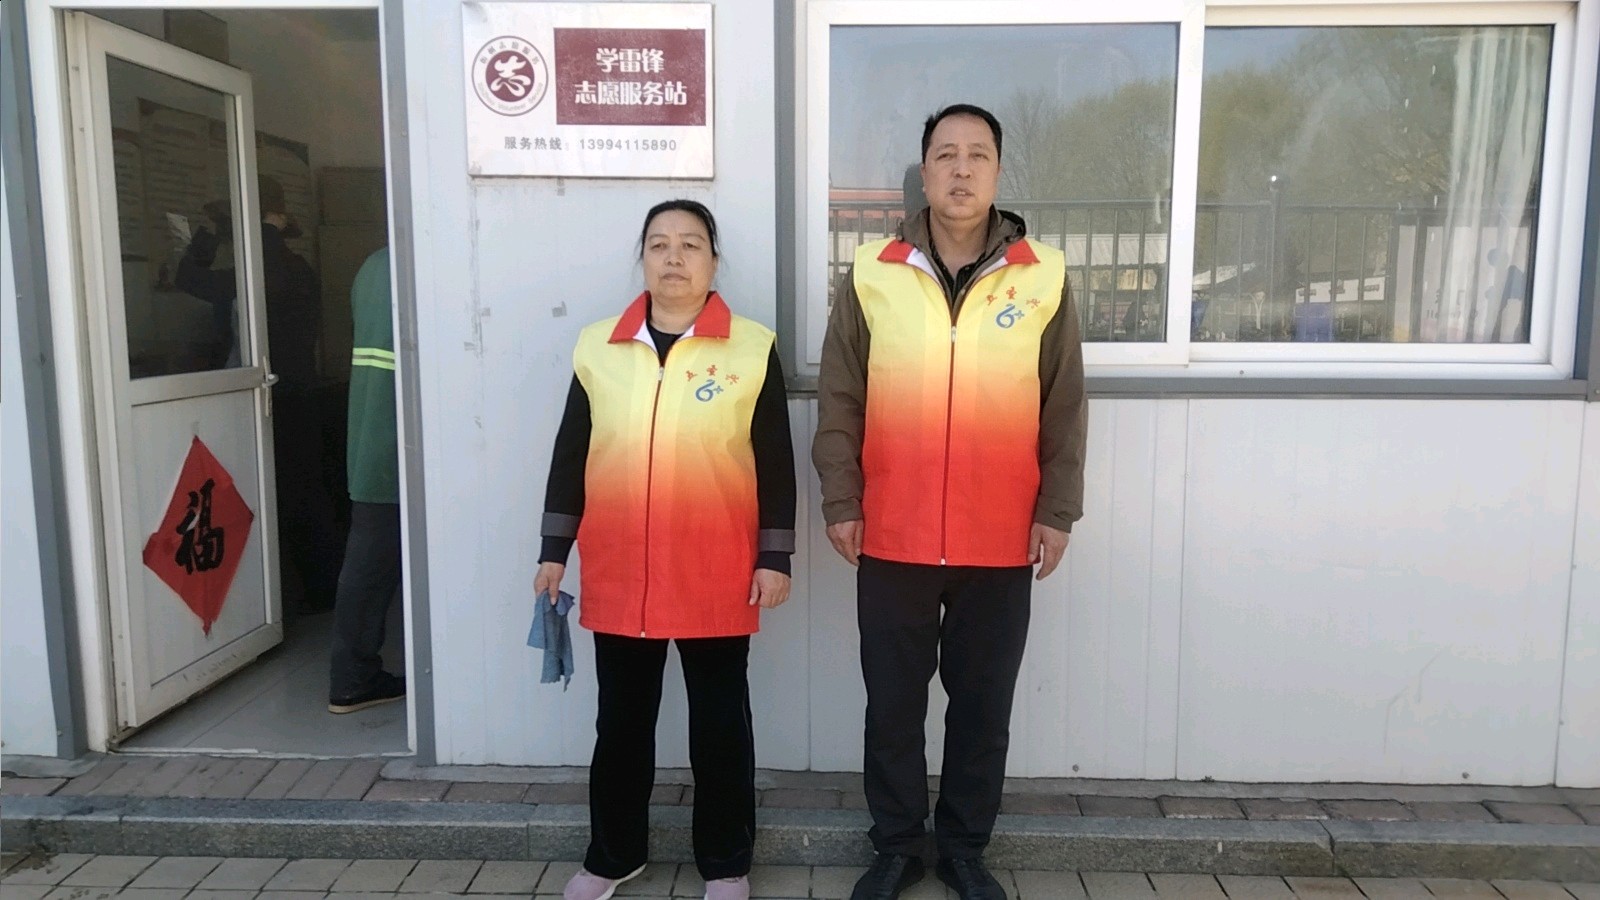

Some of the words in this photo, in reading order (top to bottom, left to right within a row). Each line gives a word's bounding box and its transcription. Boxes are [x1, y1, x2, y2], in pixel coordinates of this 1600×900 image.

[595, 47, 664, 73] 学雷锋
[574, 80, 688, 106] 志愿服务站
[579, 138, 677, 151] 13994115890
[175, 477, 226, 576] 福
